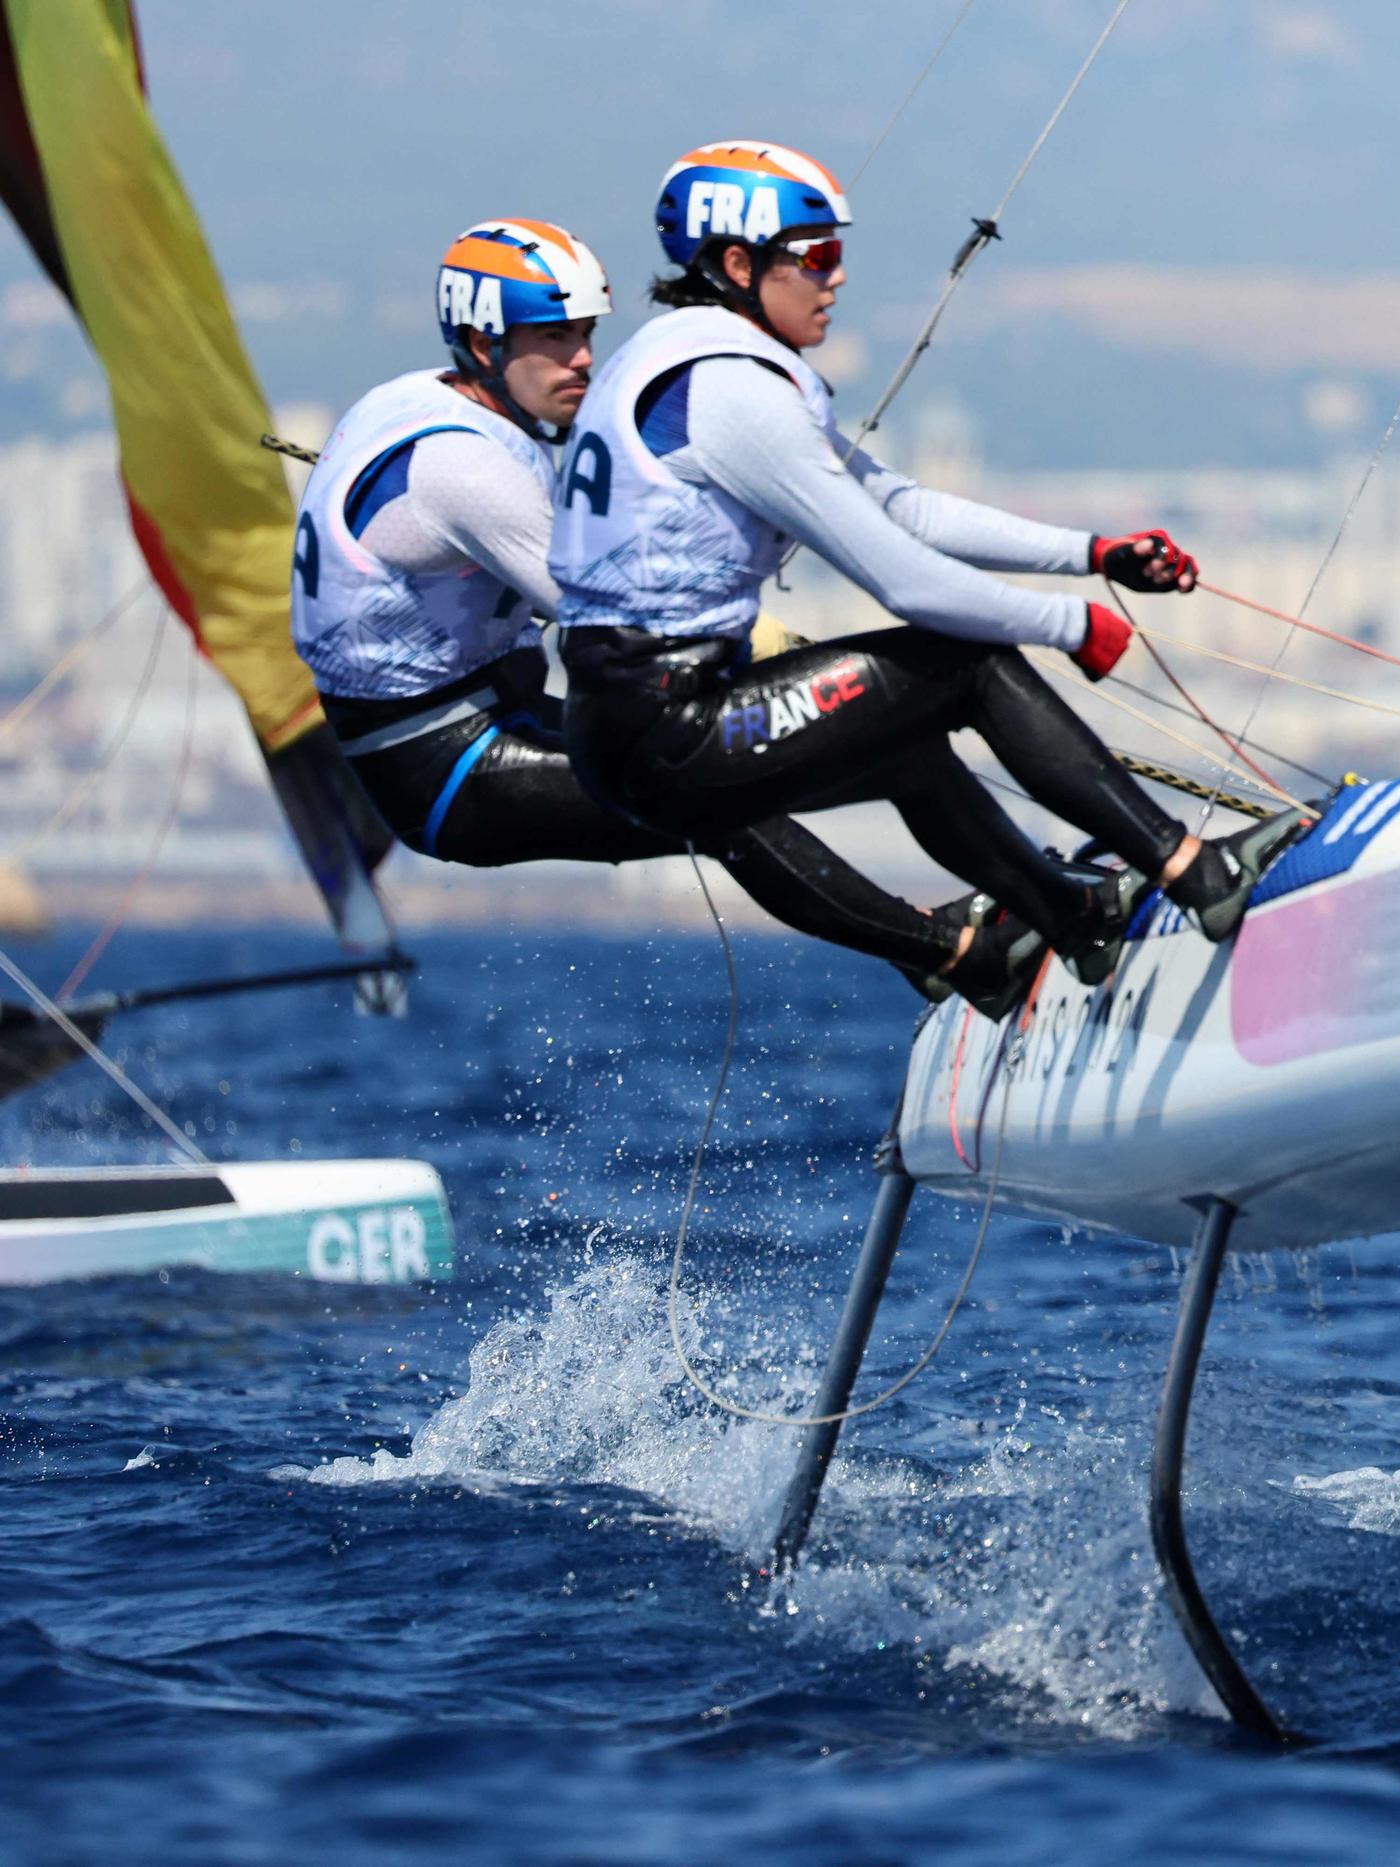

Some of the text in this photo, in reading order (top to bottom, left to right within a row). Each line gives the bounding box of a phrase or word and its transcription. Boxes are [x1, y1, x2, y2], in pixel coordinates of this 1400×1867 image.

[686, 180, 781, 243] FRA
[439, 268, 505, 335] FRA
[722, 657, 865, 749] FRANCE
[307, 1208, 430, 1285] GER
